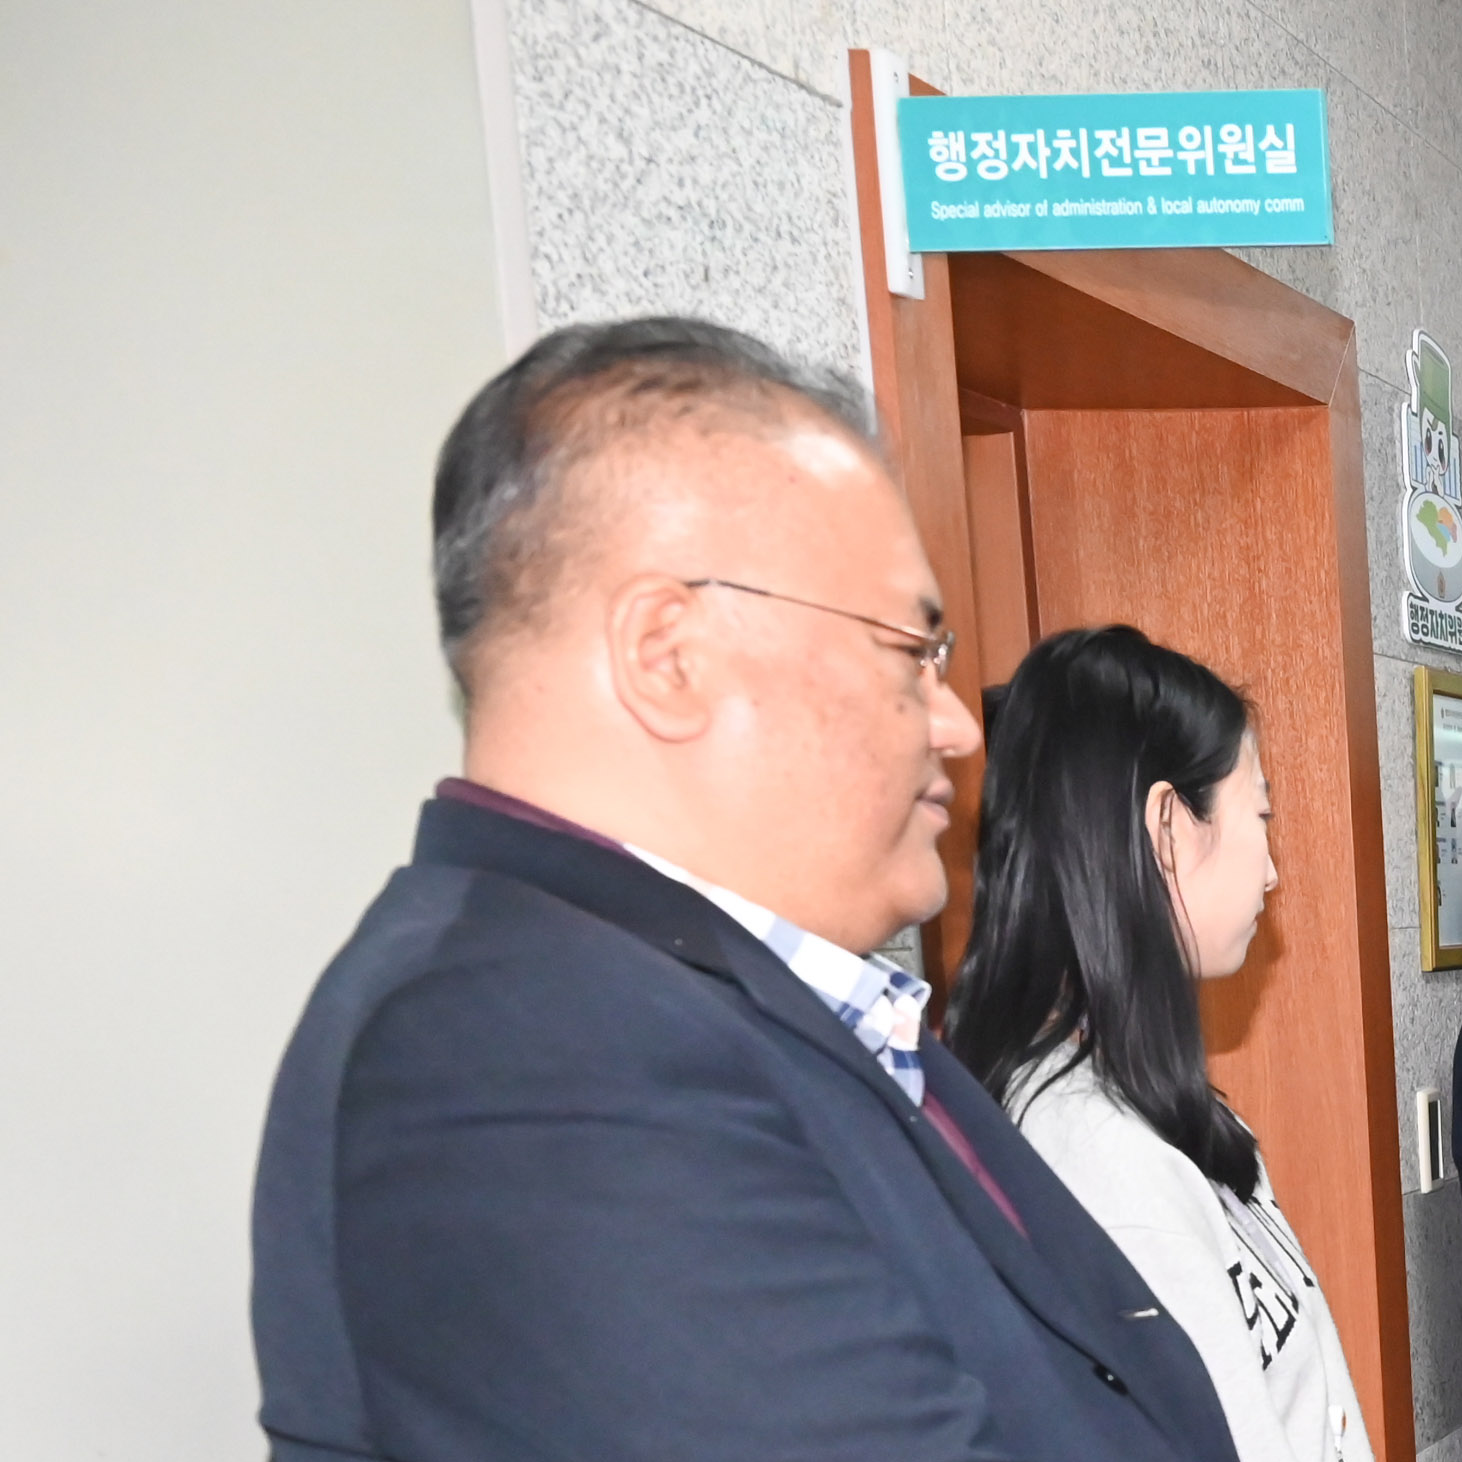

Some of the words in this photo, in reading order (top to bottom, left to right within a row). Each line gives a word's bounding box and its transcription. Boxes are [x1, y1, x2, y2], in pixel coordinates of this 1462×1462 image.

[927, 122, 1298, 182] 행정자치전문위원실
[931, 200, 980, 221] Special
[983, 200, 1031, 218] advisor
[1034, 199, 1049, 217] of
[1052, 198, 1143, 217] administration
[1146, 196, 1158, 215] &
[1161, 196, 1193, 215] local
[1197, 197, 1261, 216] autonomy
[1264, 197, 1305, 214] comm
